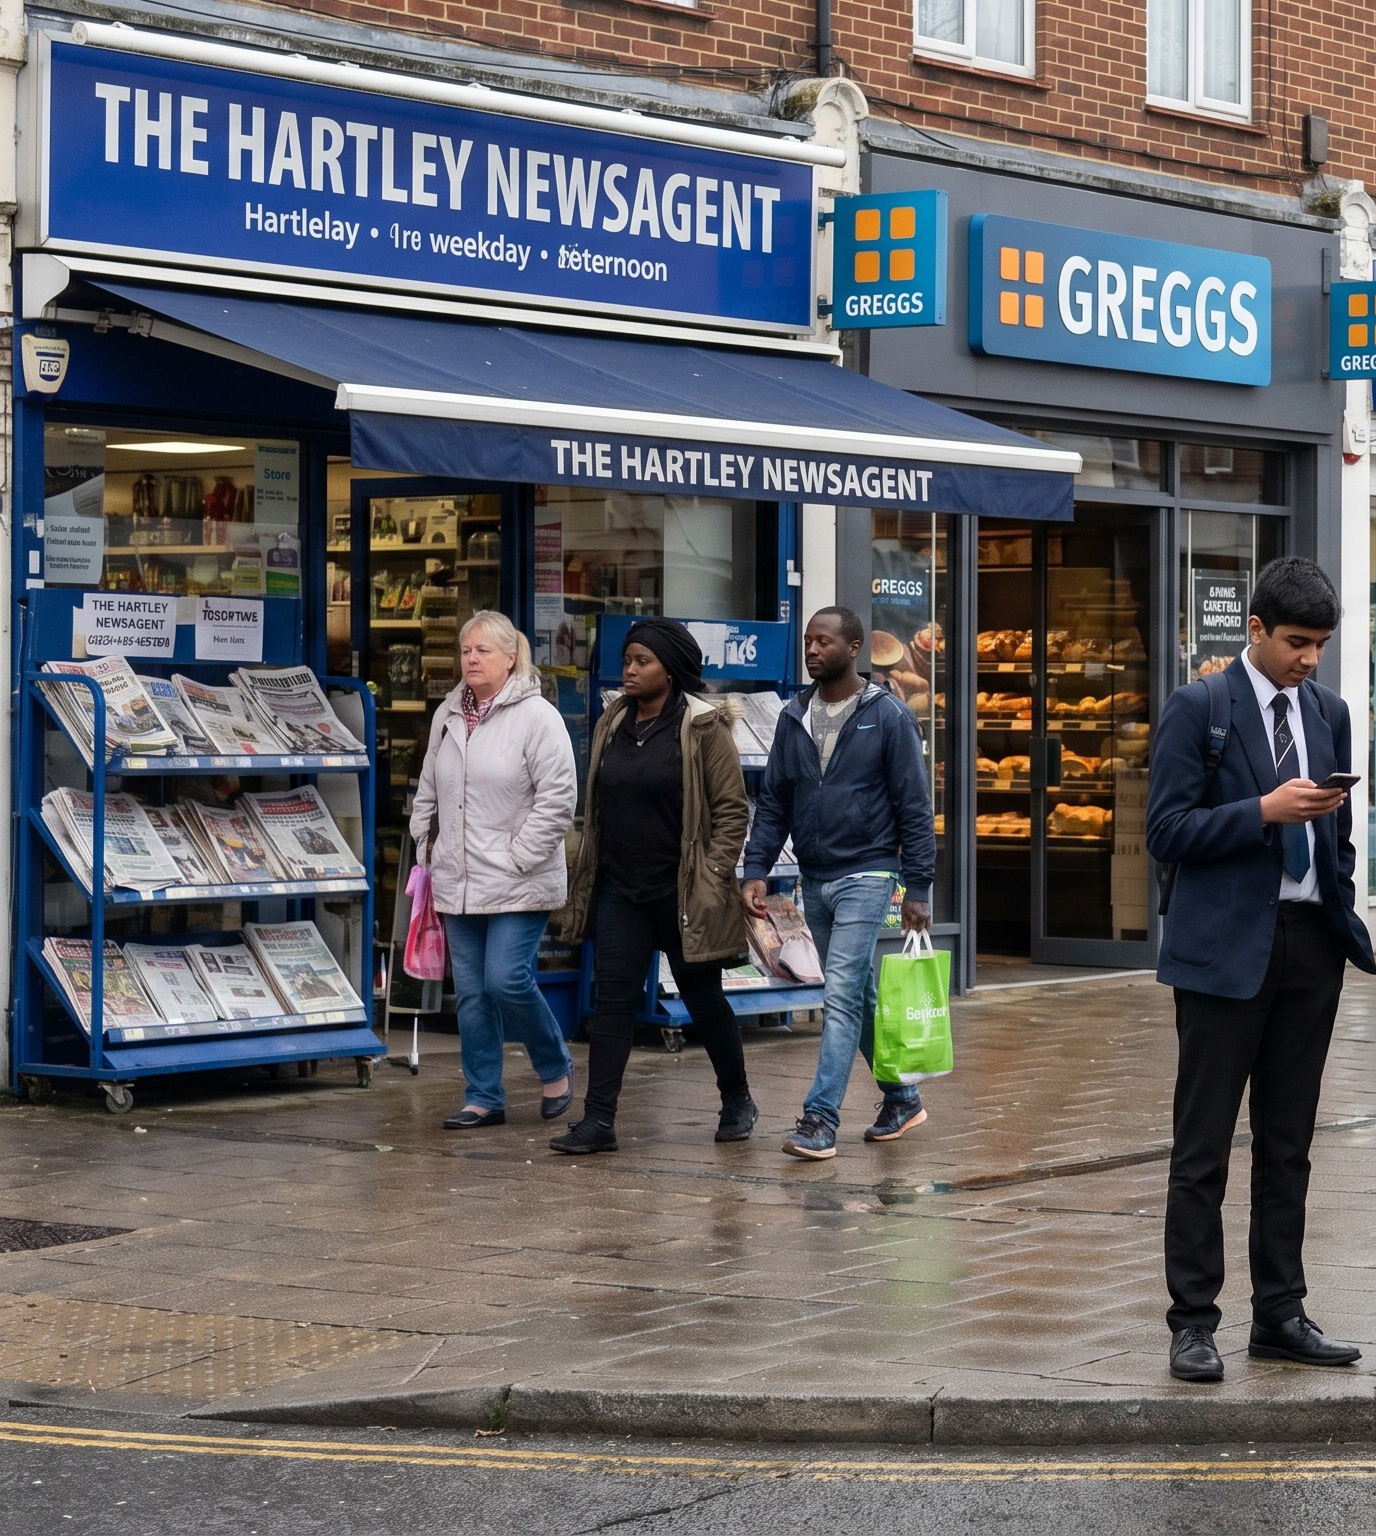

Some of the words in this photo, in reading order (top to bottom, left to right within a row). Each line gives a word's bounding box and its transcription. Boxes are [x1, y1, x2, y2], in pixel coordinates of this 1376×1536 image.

[95, 82, 209, 176] THE
[229, 103, 474, 210] HARTLEY
[487, 144, 780, 254] NEWSAGENT
[245, 202, 360, 249] Hartlelay
[430, 231, 531, 271] weekday
[845, 291, 924, 317] GREGGS
[1057, 255, 1258, 357] GREGGS
[264, 468, 291, 480] Store
[551, 439, 612, 478] THE
[621, 445, 755, 488] HARTLEY
[763, 457, 932, 501] NEWSAGENT
[872, 578, 923, 596] GREGGS
[92, 600, 114, 611] THE
[118, 601, 169, 613] HARTLEY
[96, 617, 165, 630] NEWSAGENT
